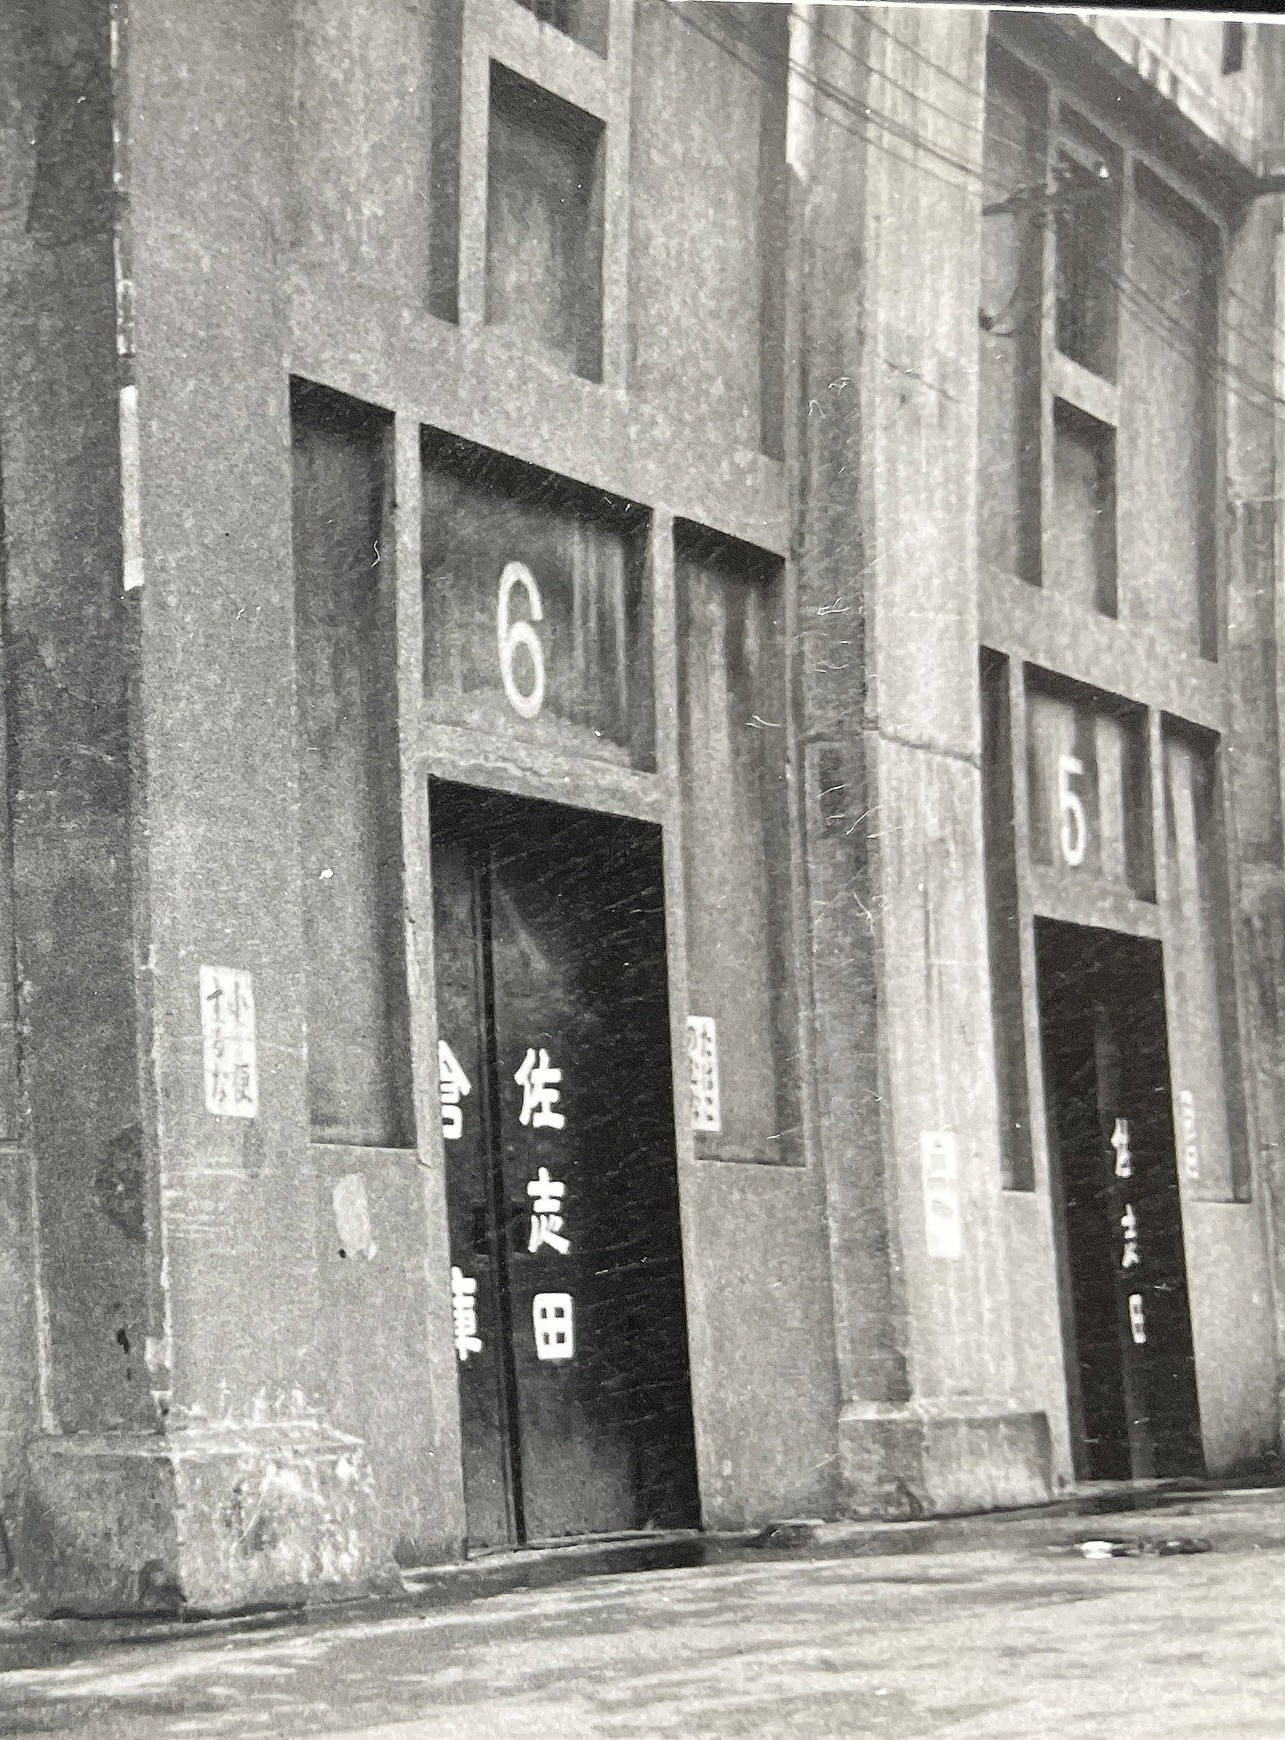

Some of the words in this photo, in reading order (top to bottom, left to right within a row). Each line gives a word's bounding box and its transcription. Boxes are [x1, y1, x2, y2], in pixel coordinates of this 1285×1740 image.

[497, 561, 546, 718] 6
[1057, 754, 1087, 866] 5
[514, 1047, 574, 1360] 佐志田
